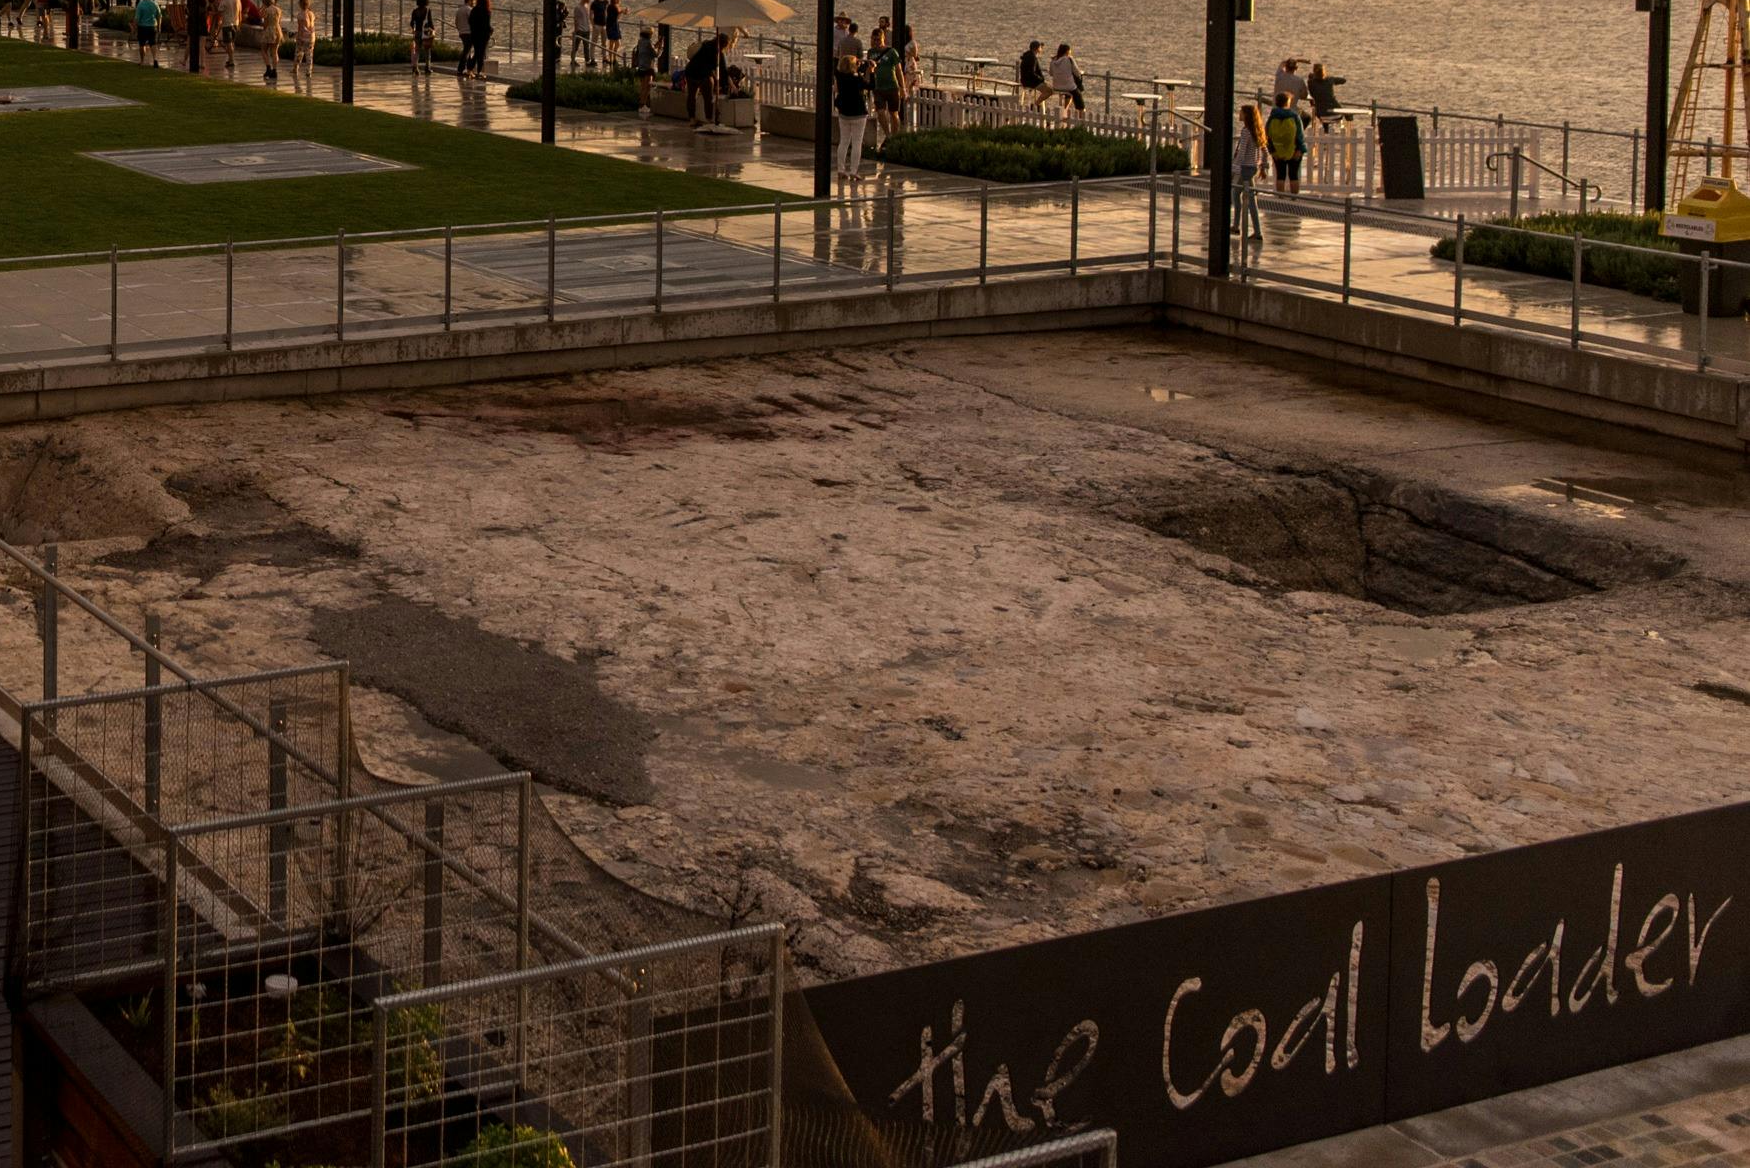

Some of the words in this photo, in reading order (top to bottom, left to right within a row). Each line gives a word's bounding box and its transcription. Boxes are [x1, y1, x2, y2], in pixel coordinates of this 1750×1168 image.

[889, 999, 1099, 1154] the
[1162, 921, 1364, 1110] Coal
[1420, 862, 1733, 1054] Loader
